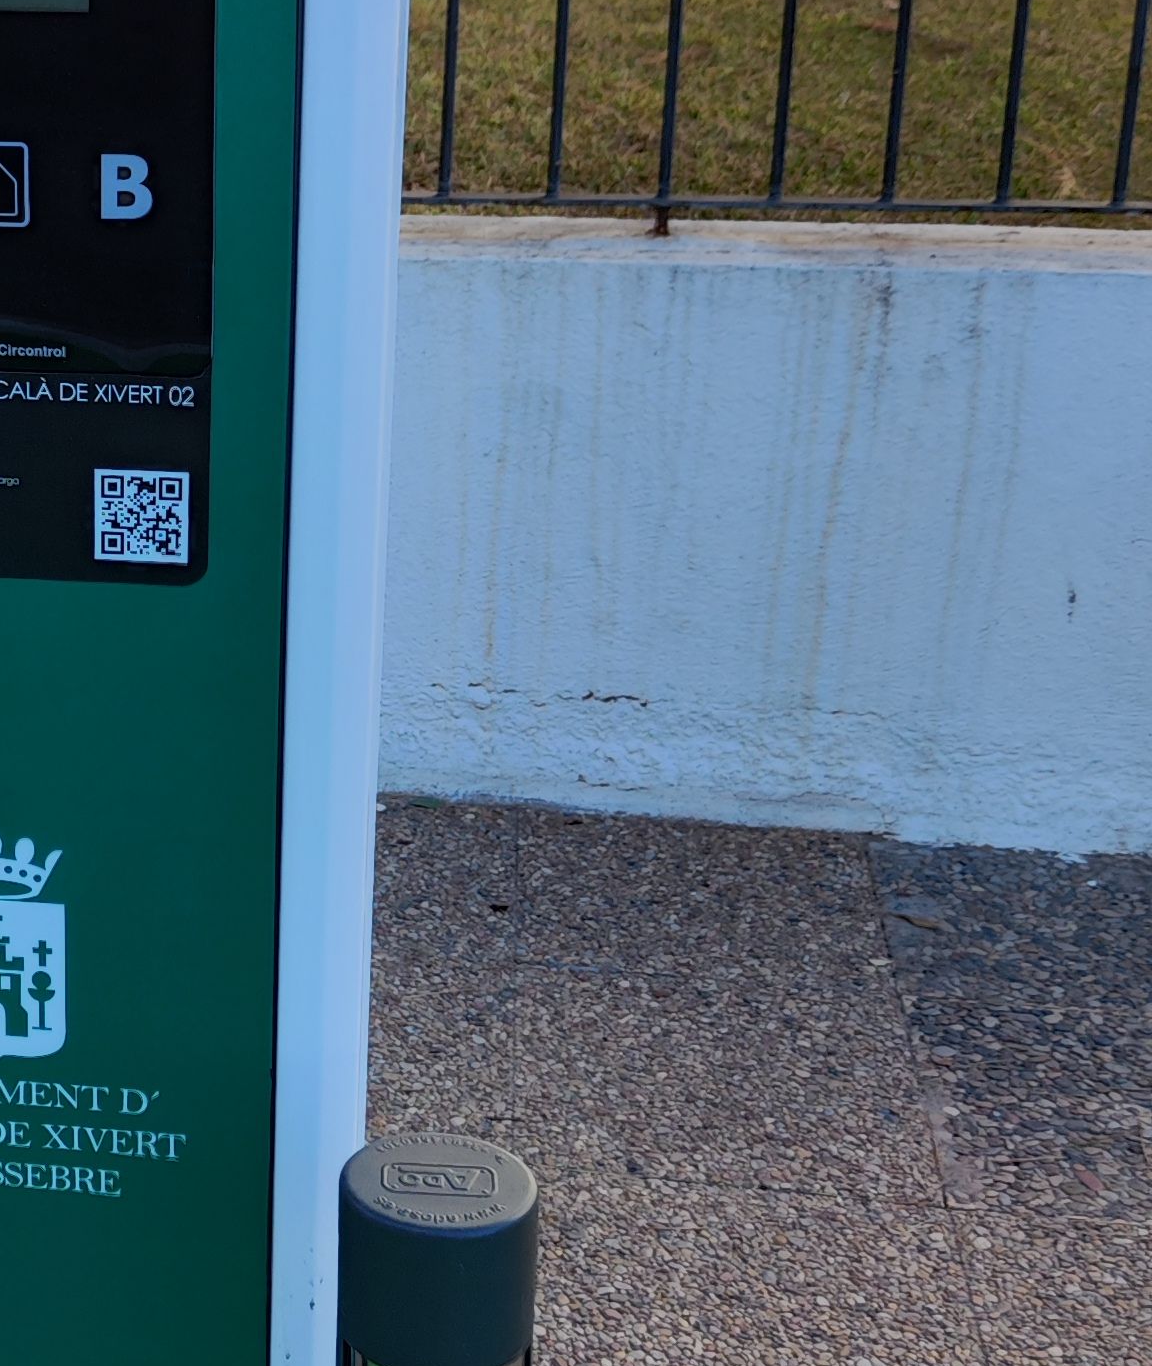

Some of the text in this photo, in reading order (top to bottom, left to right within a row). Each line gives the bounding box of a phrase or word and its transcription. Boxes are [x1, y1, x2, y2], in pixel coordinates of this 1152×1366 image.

[99, 152, 154, 221] B
[59, 382, 89, 403] DE
[94, 383, 164, 405] XIVERT
[168, 385, 195, 407] 02
[41, 1122, 188, 1164] XIVERT
